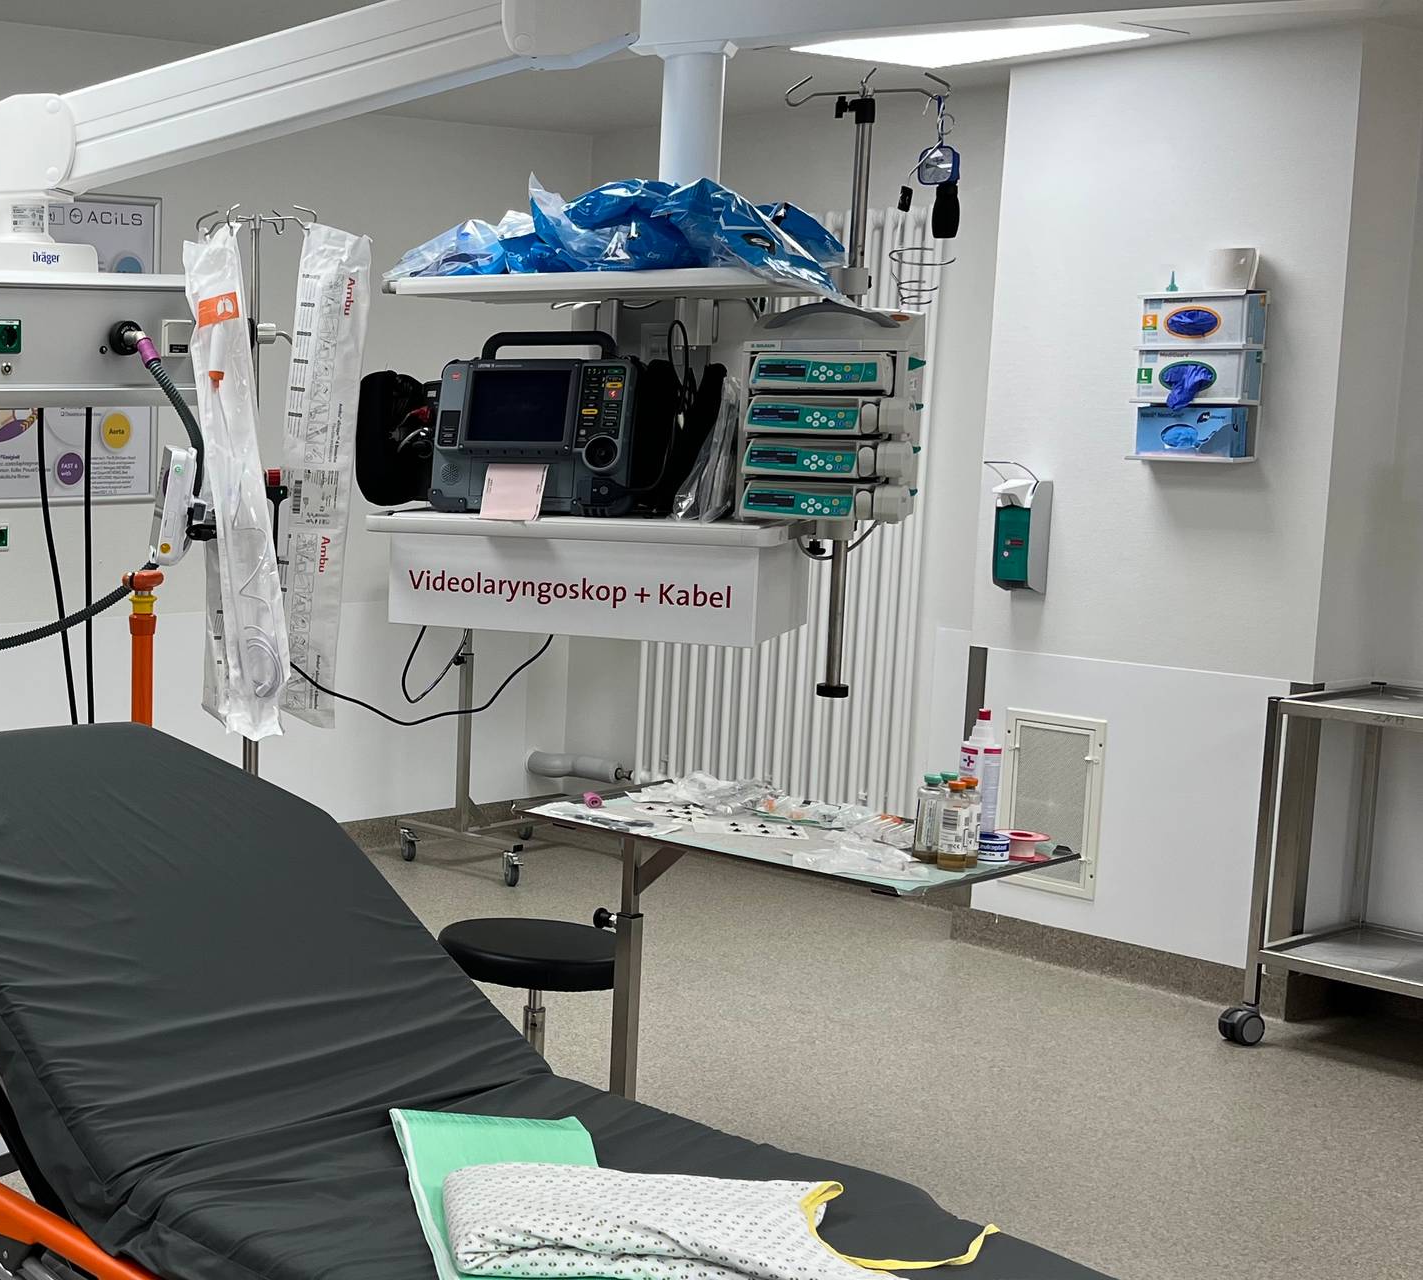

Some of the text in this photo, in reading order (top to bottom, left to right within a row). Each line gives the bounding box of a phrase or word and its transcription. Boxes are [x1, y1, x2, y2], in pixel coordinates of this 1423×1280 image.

[87, 210, 143, 226] ACiLS
[32, 251, 61, 264] Dräger
[343, 277, 356, 316] Ambu
[318, 536, 331, 573] Ambu
[409, 569, 732, 609] Videolaryngoskop + Kabel
